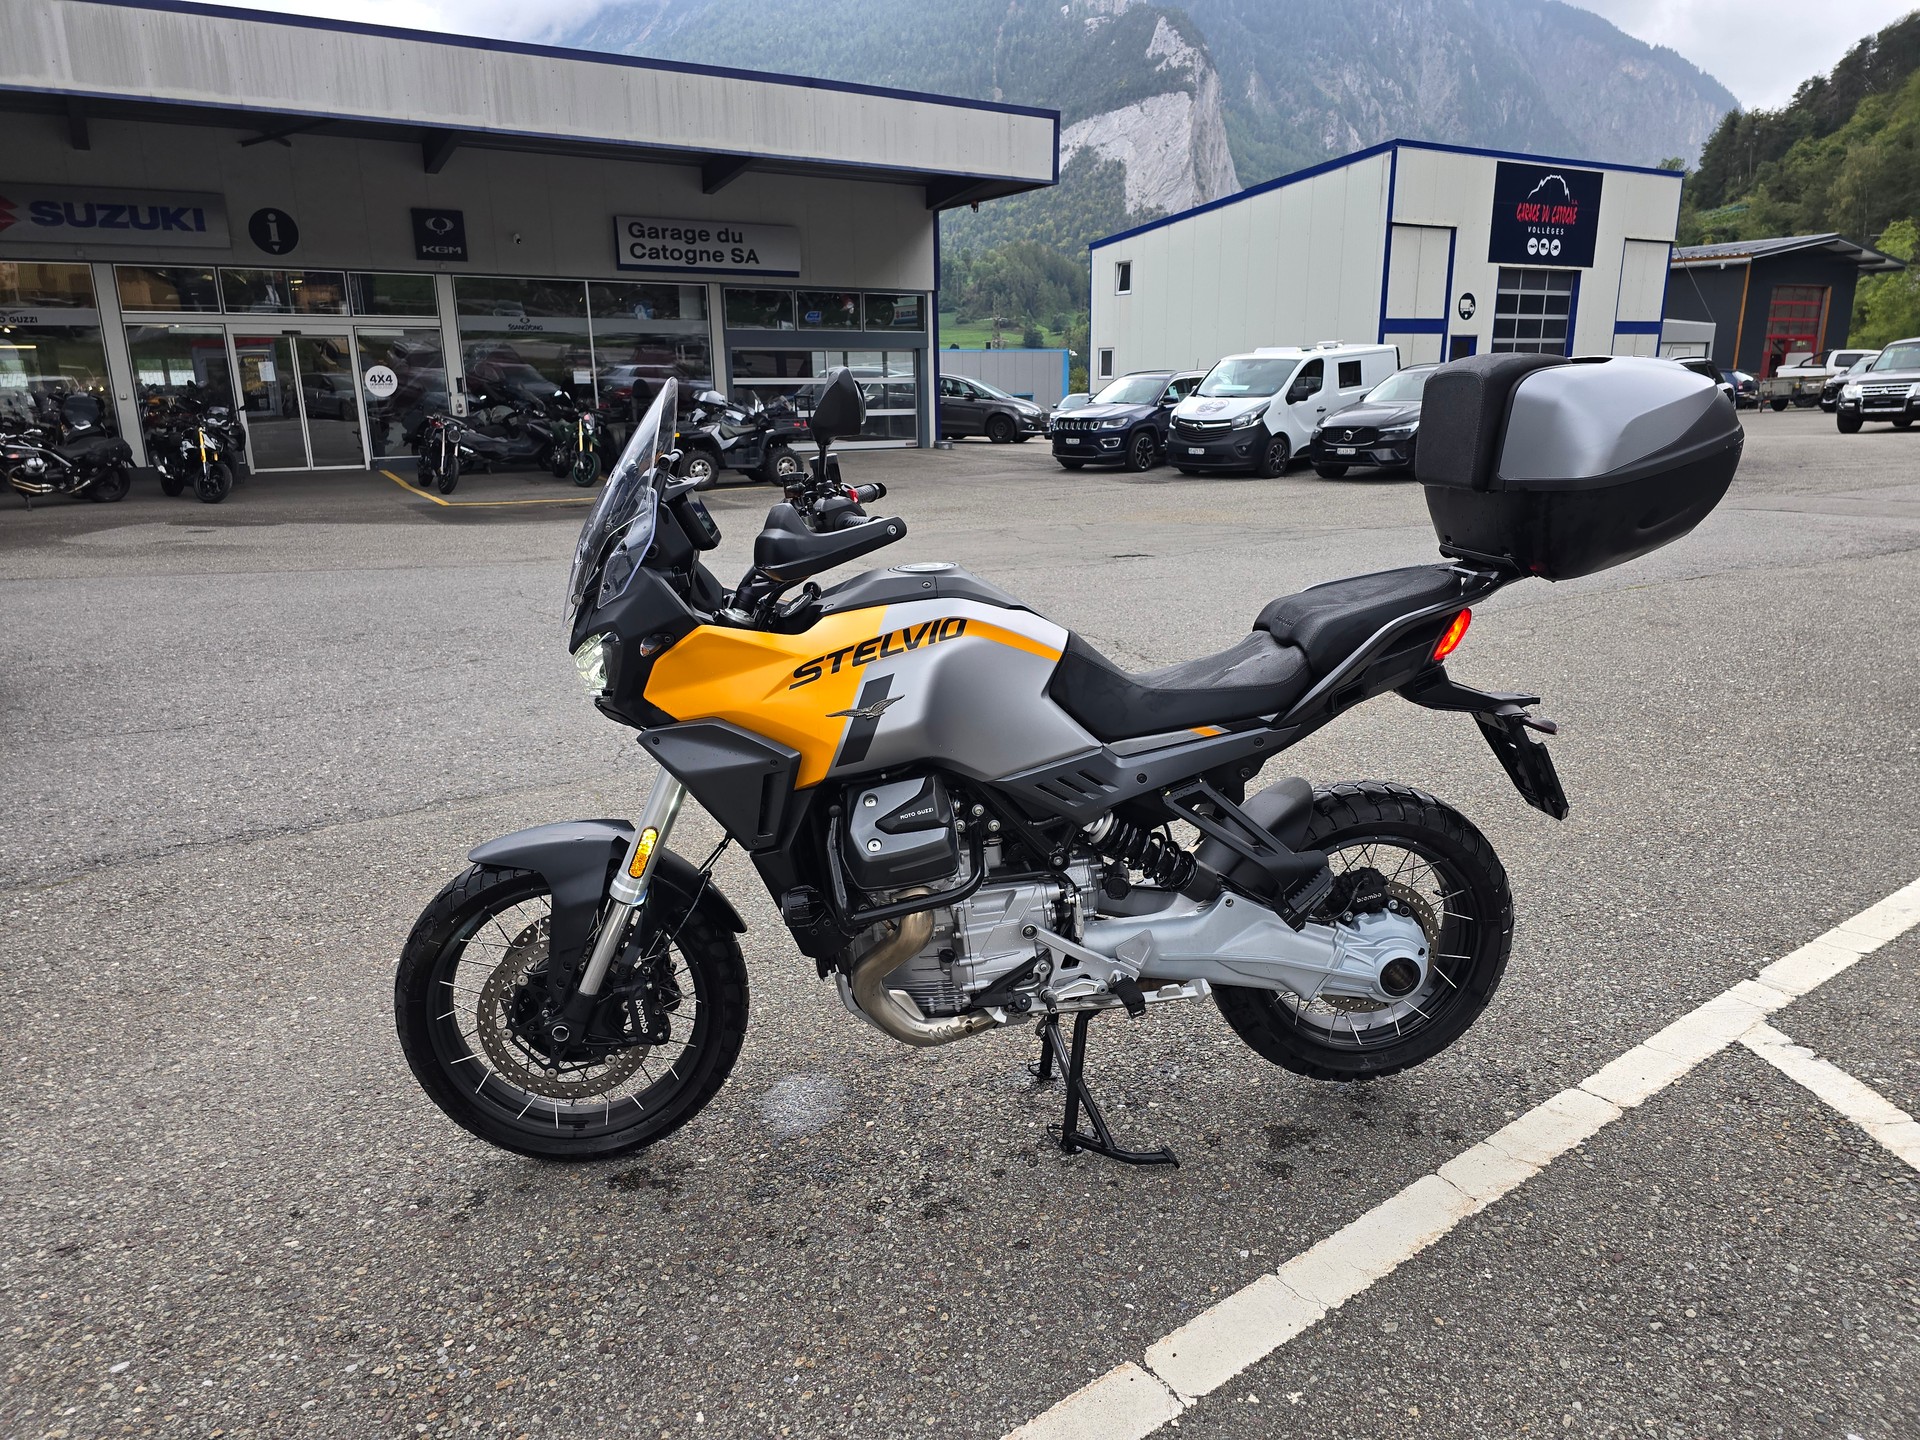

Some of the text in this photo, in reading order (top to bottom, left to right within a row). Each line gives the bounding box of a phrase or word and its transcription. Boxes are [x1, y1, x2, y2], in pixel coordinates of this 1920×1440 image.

[29, 200, 207, 232] SUZUKI
[1516, 202, 1540, 222] GARAGE
[1551, 205, 1578, 225] CATOGNE
[628, 222, 743, 245] Garage du
[1528, 226, 1564, 235] VOLLÈGES
[422, 245, 462, 254] KGM
[629, 243, 760, 265] Catogne SA
[789, 617, 968, 690] STELVIO
[900, 807, 934, 820] MOTO GUZZI
[1357, 892, 1382, 903] brembo
[635, 999, 649, 1034] brembo
